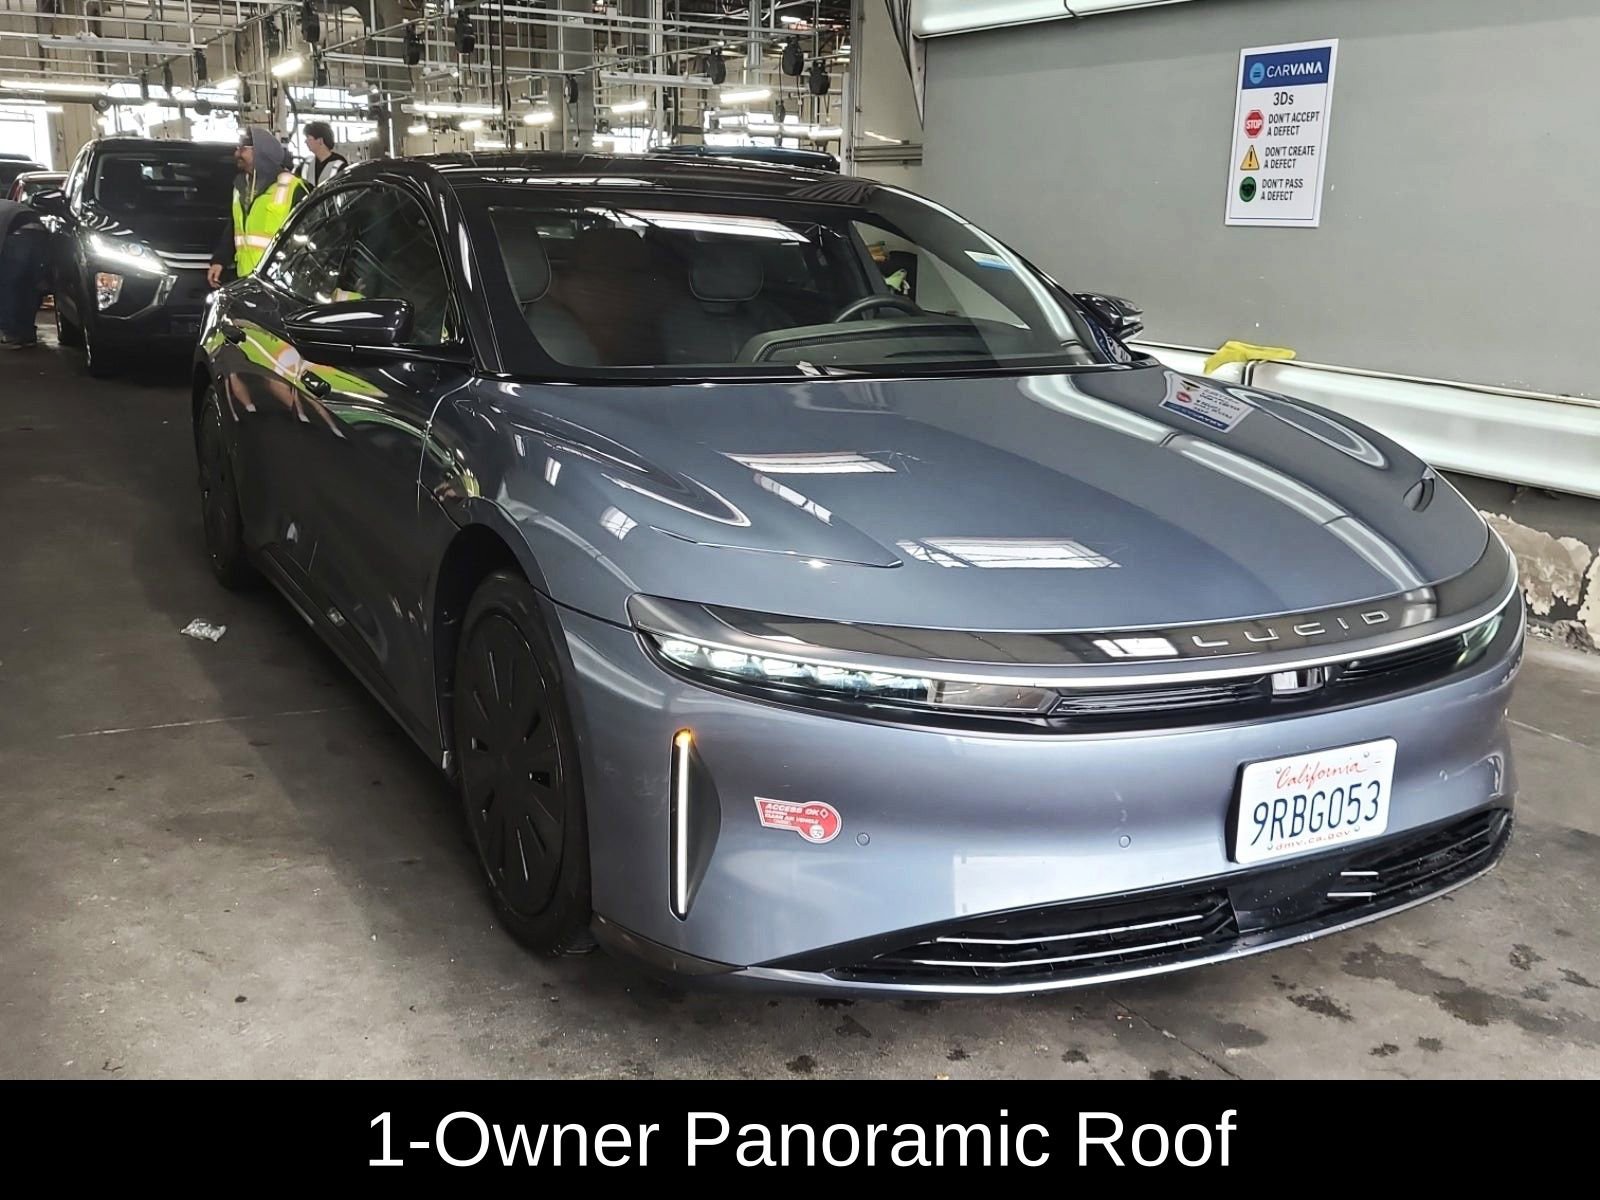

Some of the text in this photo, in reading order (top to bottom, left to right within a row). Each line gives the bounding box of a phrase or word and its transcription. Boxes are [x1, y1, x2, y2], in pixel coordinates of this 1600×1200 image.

[1266, 61, 1323, 78] CARVANA
[1273, 91, 1294, 106] 3Ds
[1268, 111, 1320, 124] DON'T ACCEPT
[1246, 119, 1262, 130] STOP
[1267, 125, 1300, 136] A DEFECT
[1265, 145, 1315, 157] DON'T CREATE
[1263, 158, 1296, 169] A DEFECT
[1261, 178, 1303, 188] DON'T PASS
[1260, 191, 1293, 200] A DEFECT
[1191, 609, 1391, 649] LUCID
[1275, 761, 1368, 790] California
[765, 803, 803, 814] ACCESS
[804, 807, 820, 817] OK
[1250, 779, 1381, 847] 9RBG053
[1275, 830, 1351, 851] dmv.ca.gov
